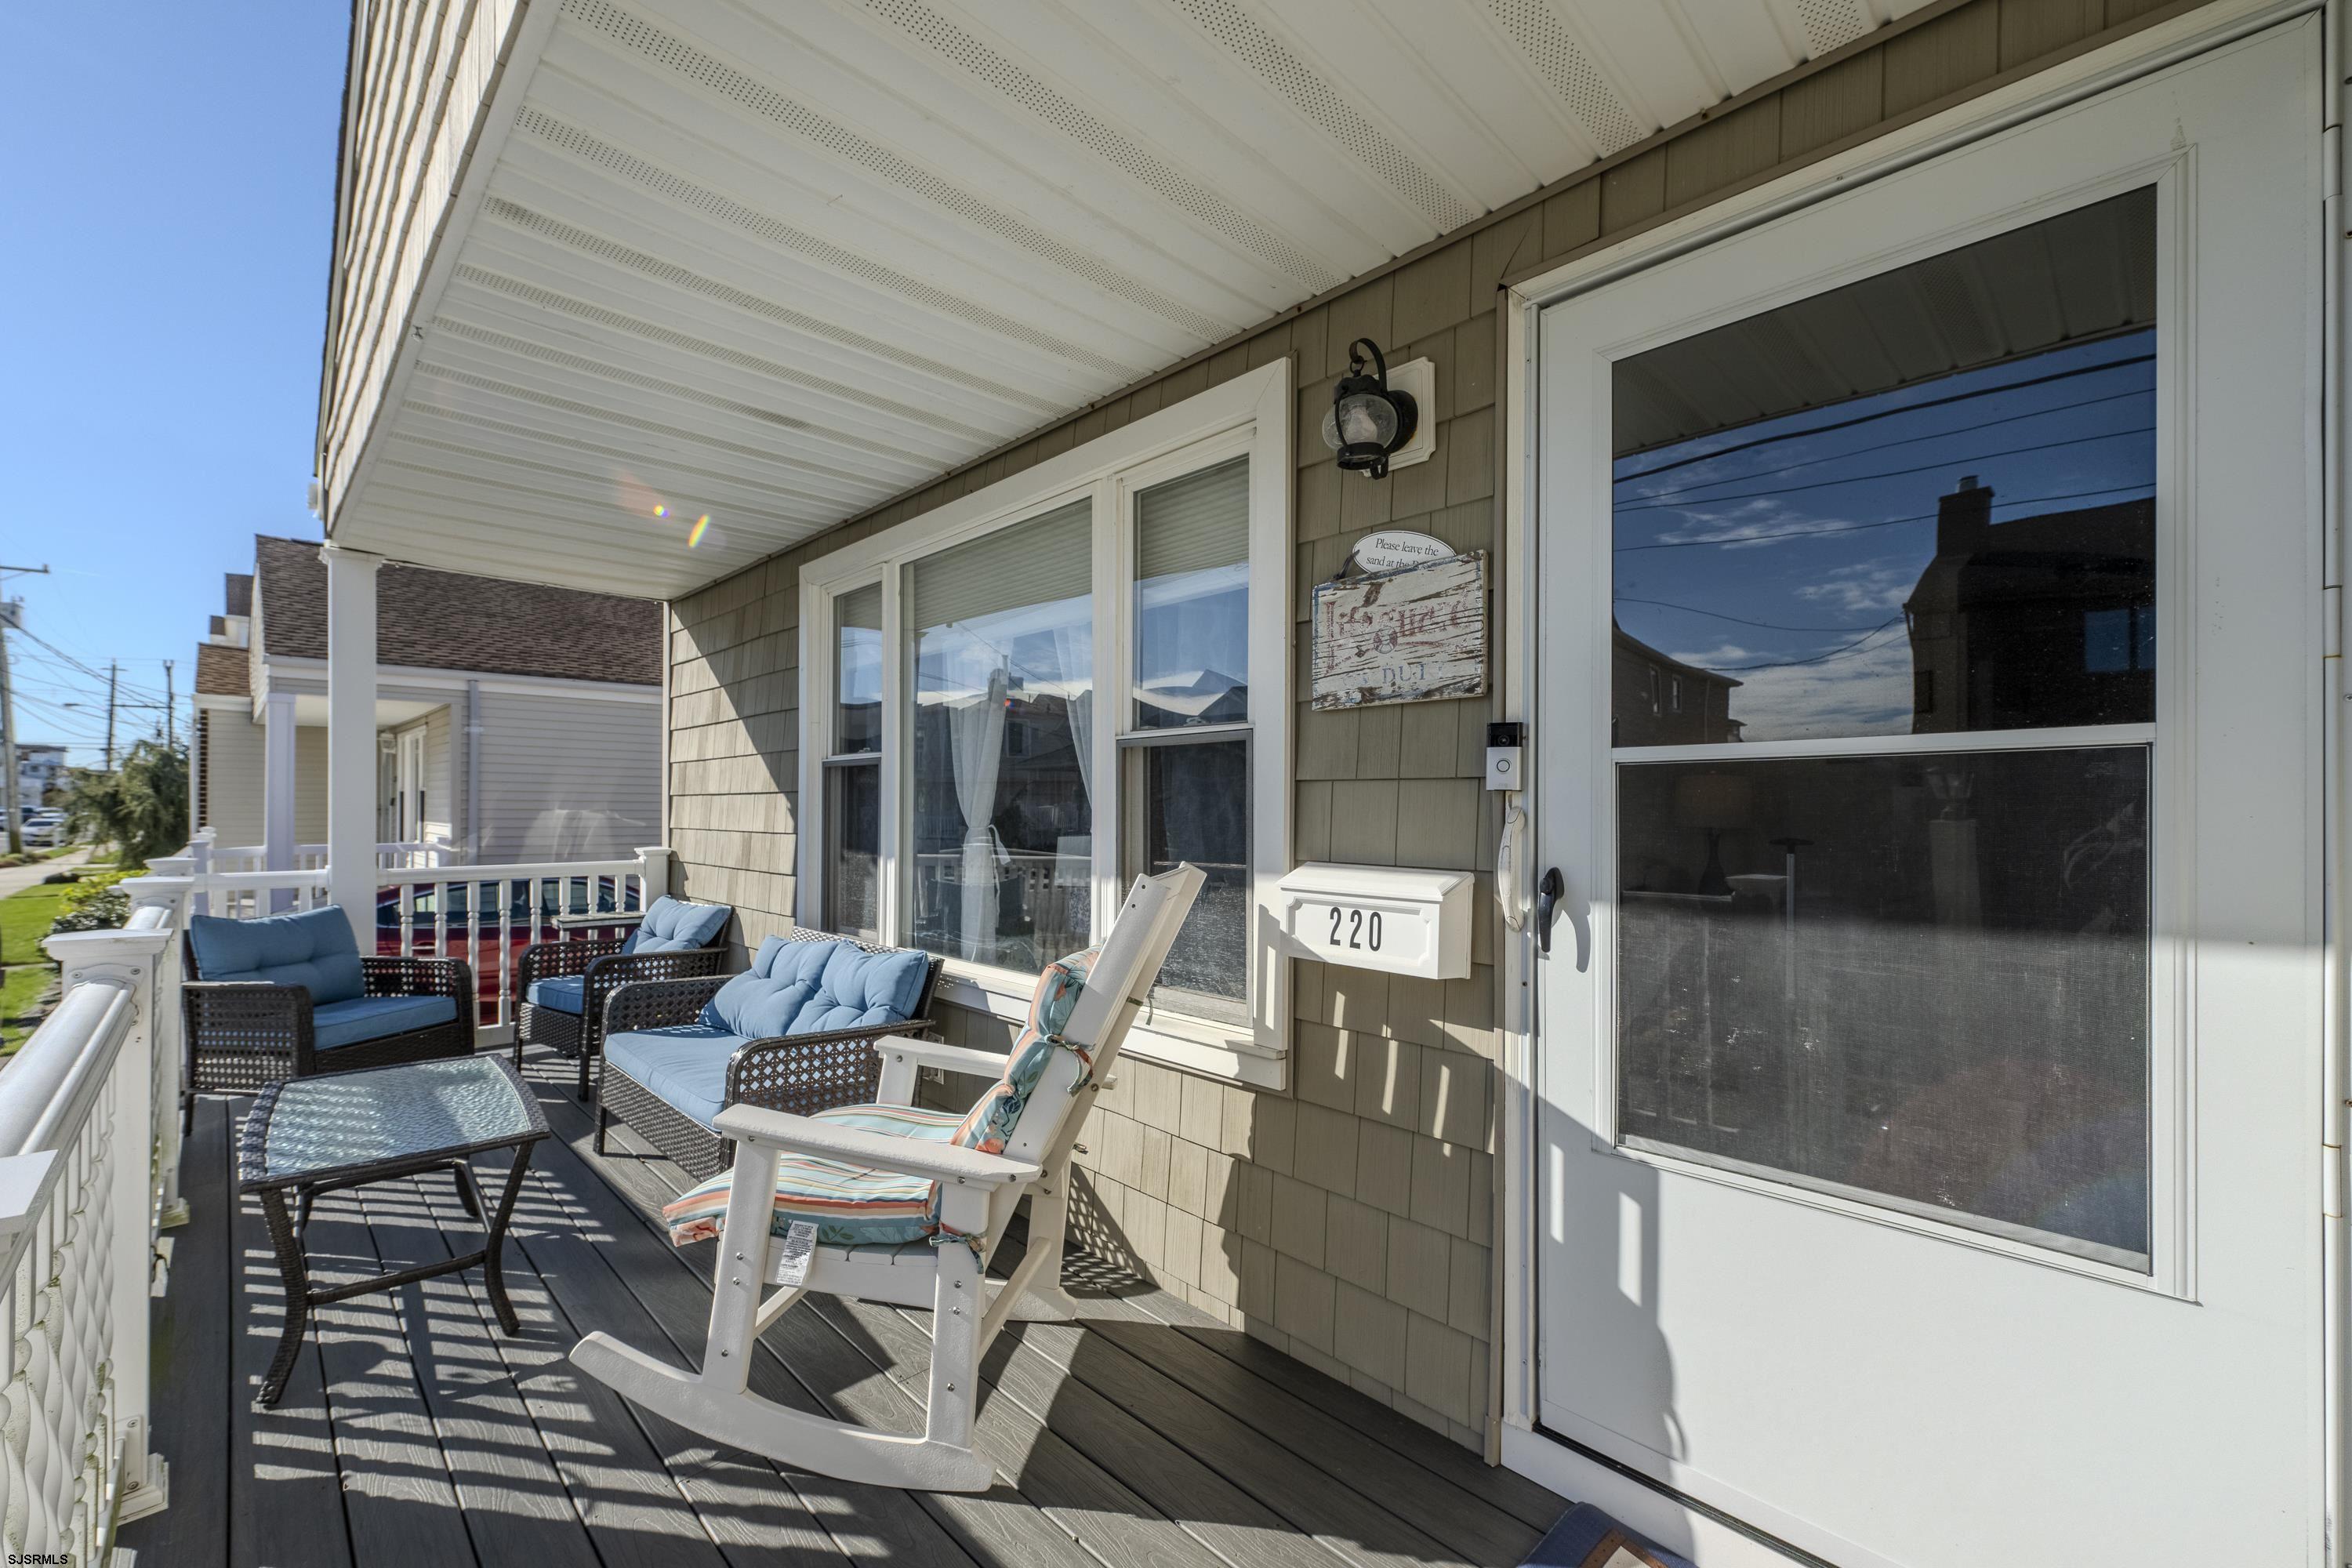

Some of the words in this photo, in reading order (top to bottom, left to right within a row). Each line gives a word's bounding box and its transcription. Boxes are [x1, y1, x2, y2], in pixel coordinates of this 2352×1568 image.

[1375, 538, 1400, 551] Please
[1401, 541, 1423, 554] leave
[1425, 545, 1439, 557] the
[1366, 556, 1386, 566] sand
[1330, 906, 1382, 952] 220
